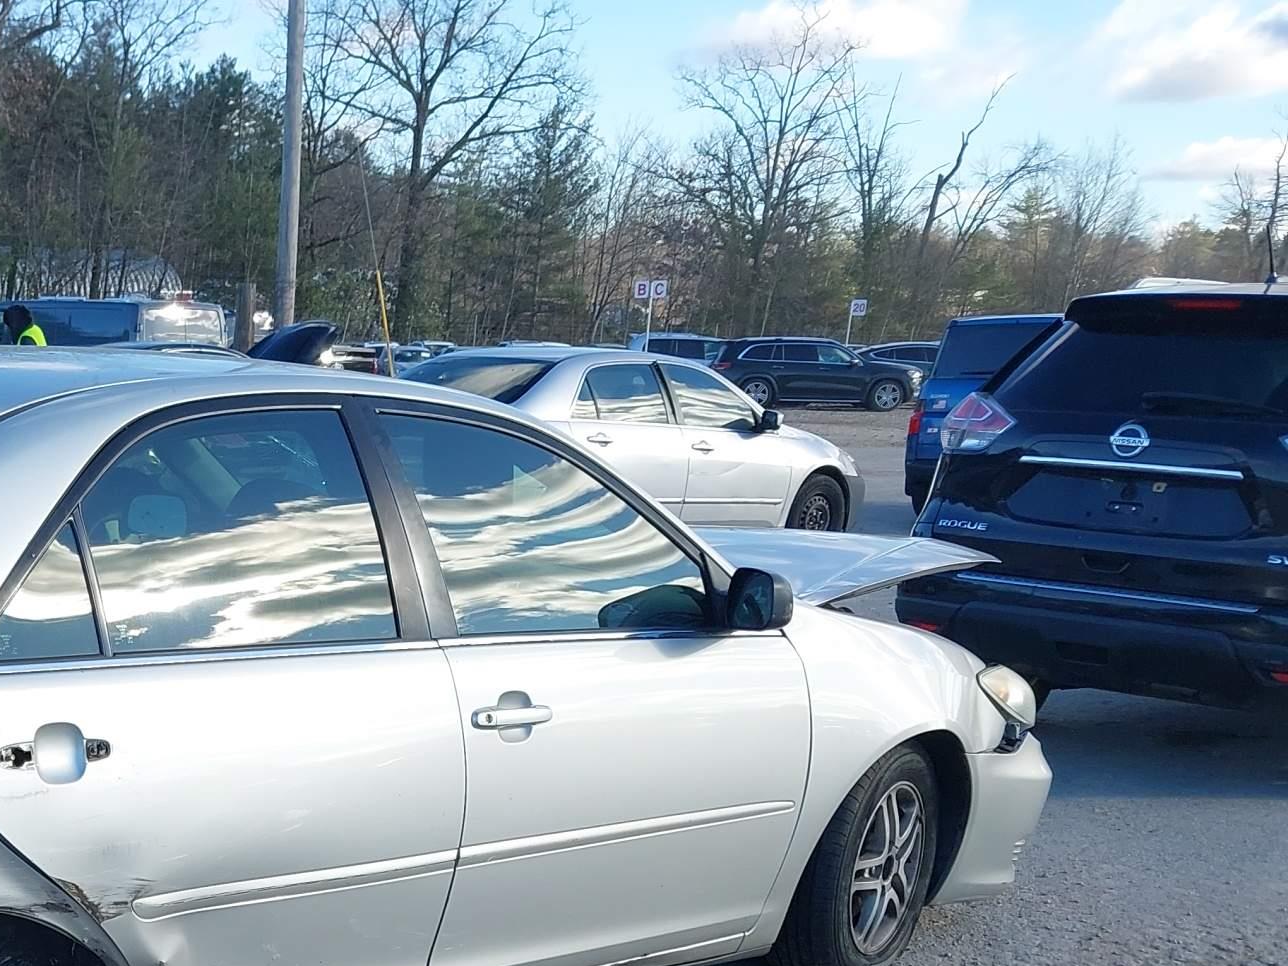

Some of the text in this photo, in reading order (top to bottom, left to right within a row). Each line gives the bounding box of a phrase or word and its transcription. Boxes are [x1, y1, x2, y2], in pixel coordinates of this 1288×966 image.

[637, 283, 647, 296] B
[654, 282, 665, 296] C
[852, 303, 866, 313] 20
[1112, 437, 1145, 446] NISSAN
[938, 519, 988, 531] ROGUE
